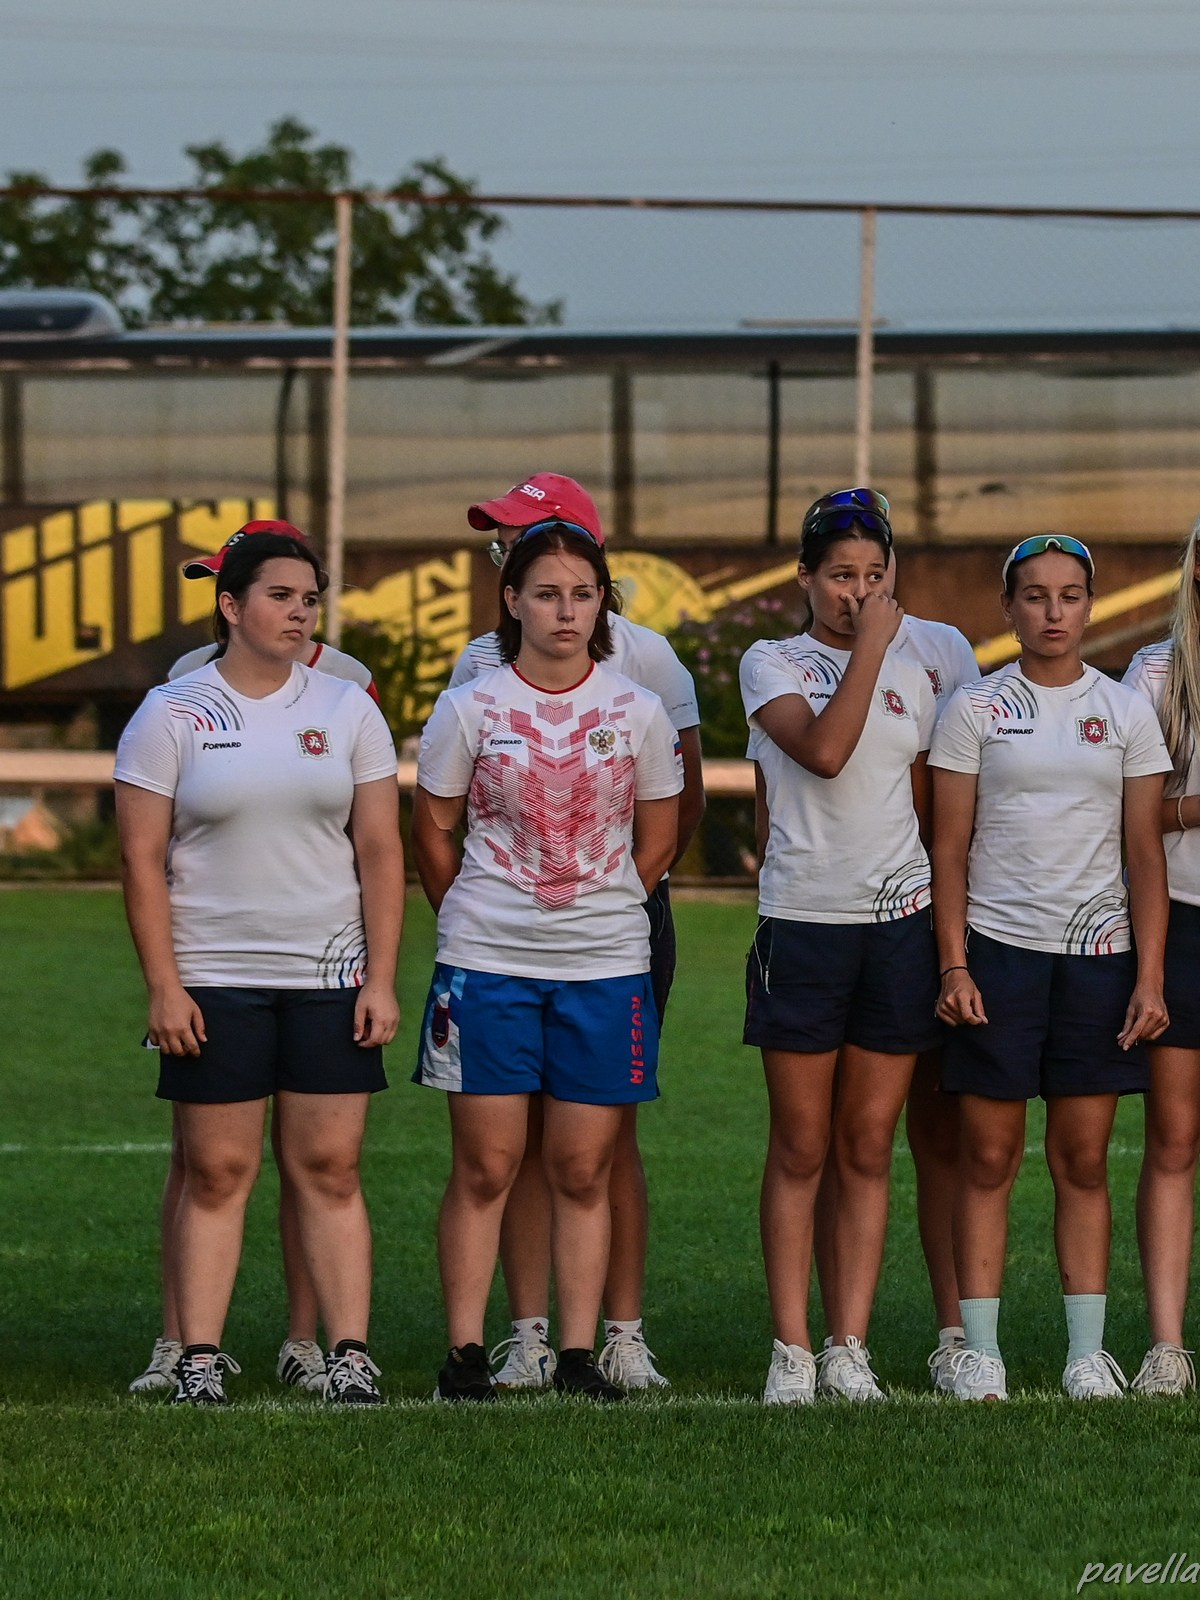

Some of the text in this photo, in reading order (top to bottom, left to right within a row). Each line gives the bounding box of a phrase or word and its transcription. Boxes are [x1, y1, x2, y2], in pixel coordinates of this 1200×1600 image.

[513, 484, 546, 501] SIA
[997, 727, 1034, 735] FORWARD
[203, 742, 242, 751] FORWARD
[490, 738, 523, 747] FORWARD
[630, 995, 645, 1085] RUSSIA
